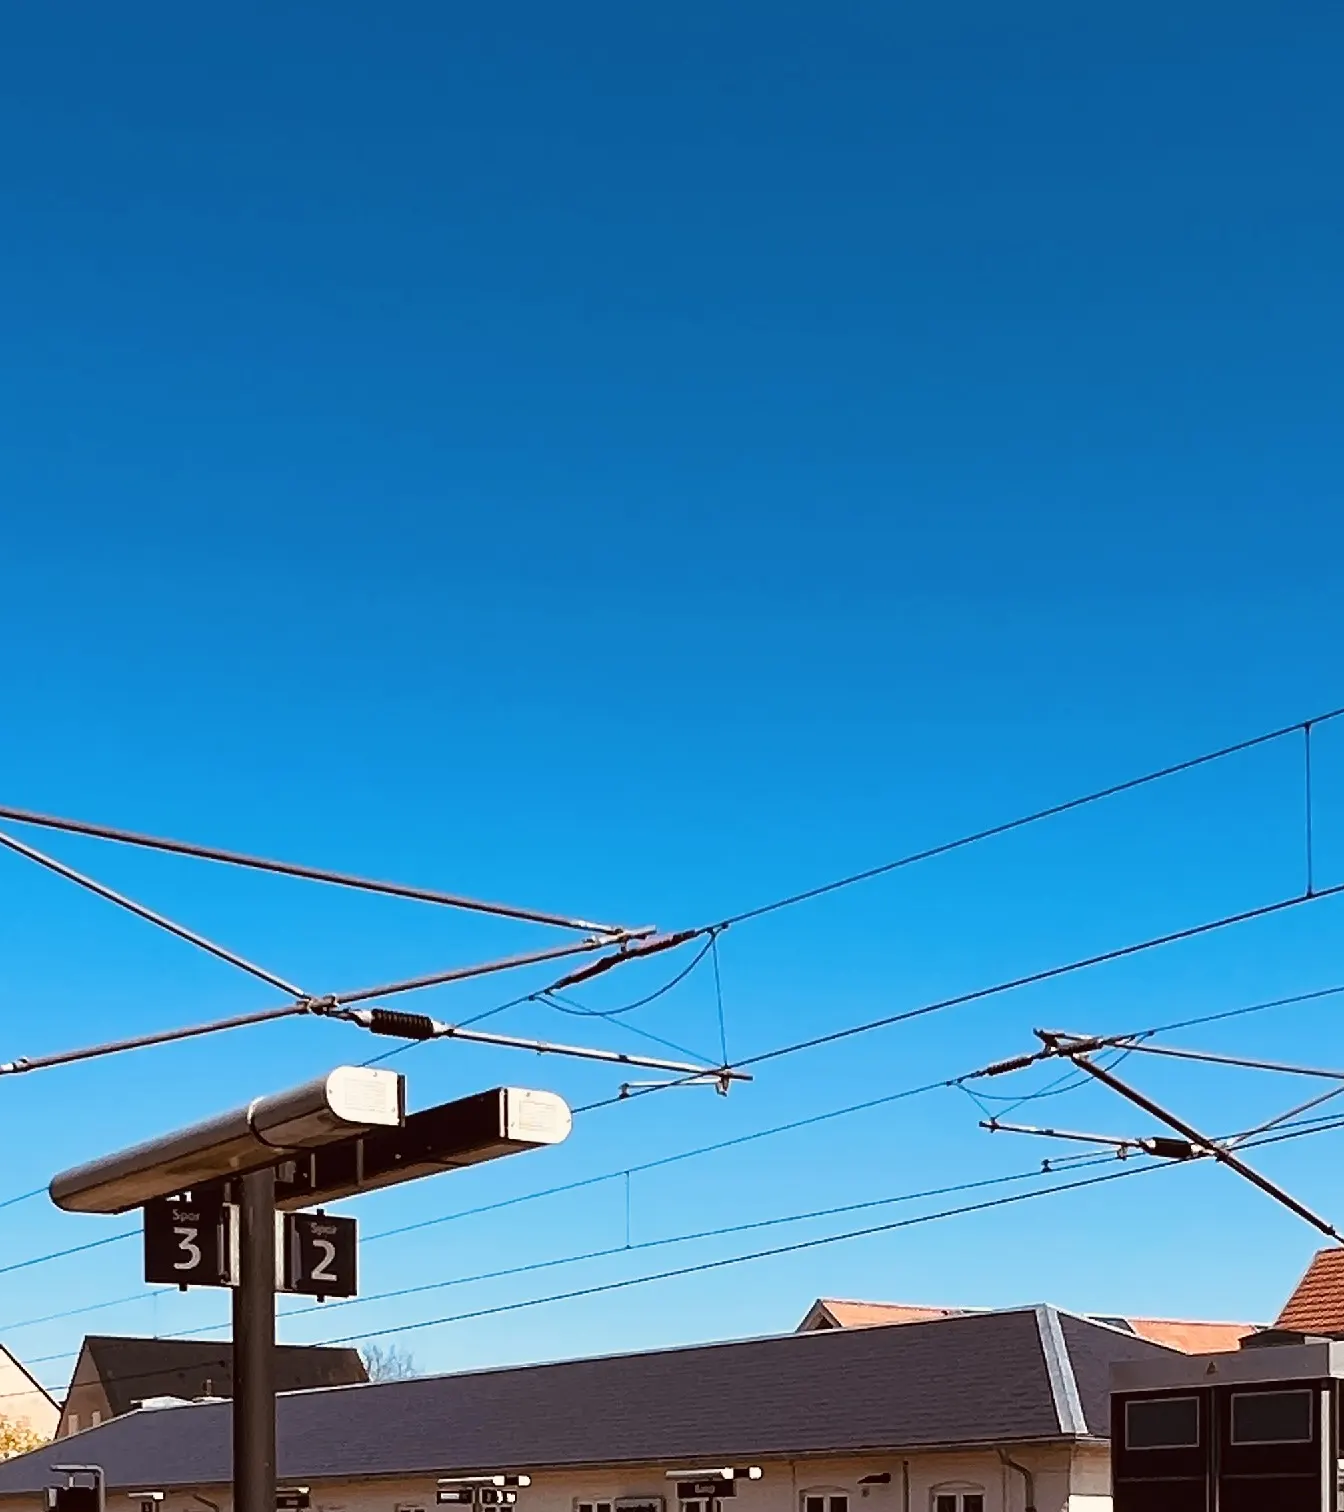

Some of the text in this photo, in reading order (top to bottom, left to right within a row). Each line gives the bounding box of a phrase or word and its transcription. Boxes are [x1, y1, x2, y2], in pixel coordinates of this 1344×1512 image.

[172, 1208, 201, 1223] Spor
[172, 1226, 202, 1270] 3
[310, 1238, 338, 1282] 2
